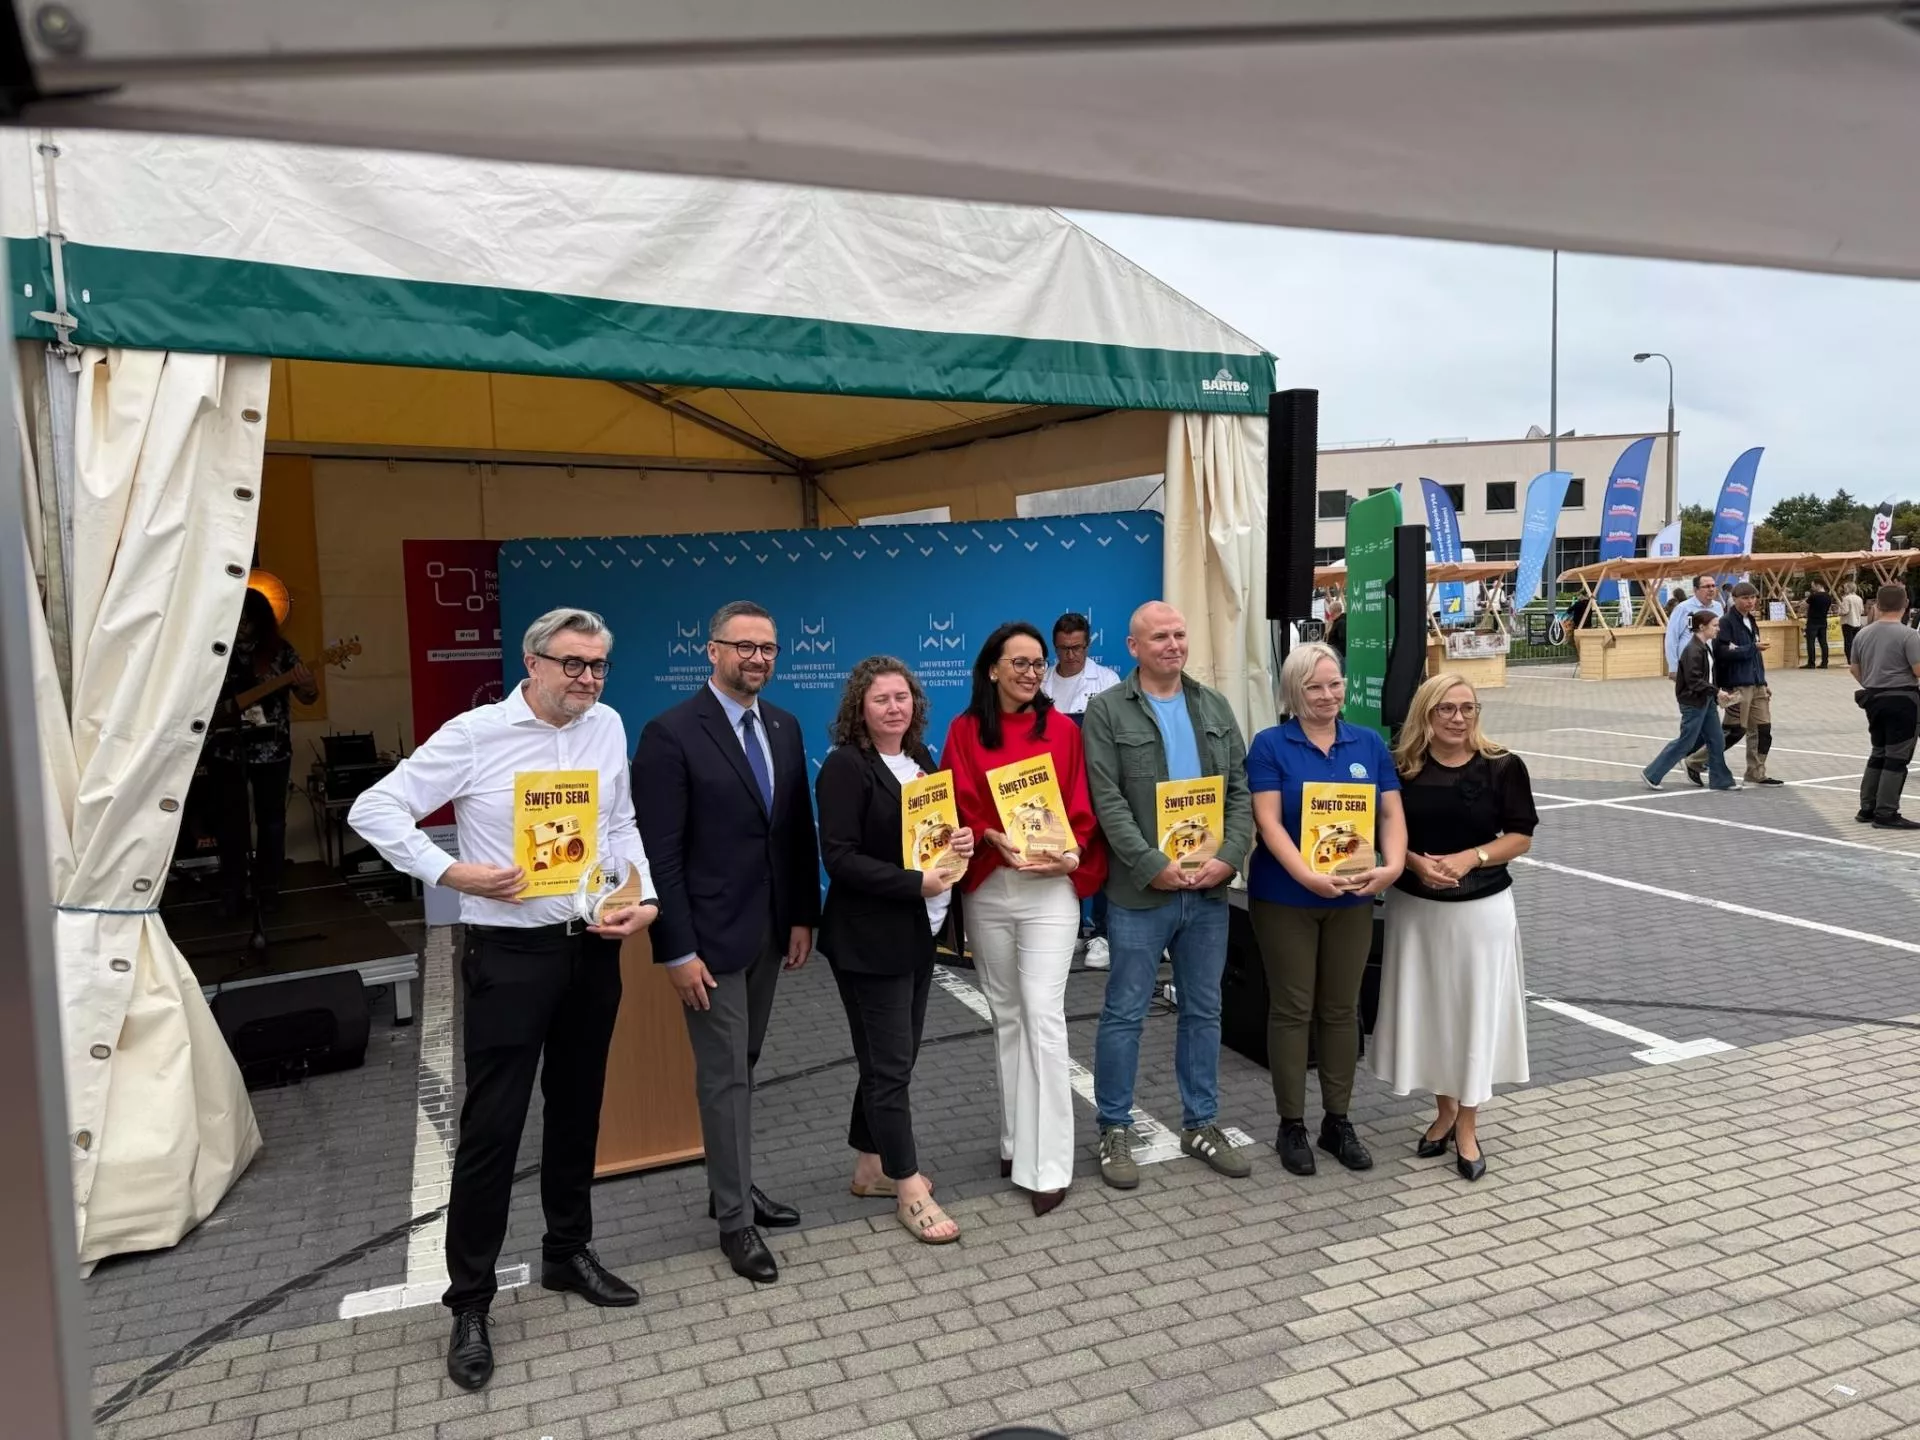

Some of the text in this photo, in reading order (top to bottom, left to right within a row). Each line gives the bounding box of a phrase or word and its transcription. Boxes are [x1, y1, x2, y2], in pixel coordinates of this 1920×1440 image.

[998, 771, 1050, 796] ŚWIĘTO SERA
[525, 789, 590, 809] ŚWIĘTO SERA
[907, 788, 948, 810] ŚWIĘTO SERA
[1164, 793, 1216, 811] ŚWIĘTO SERA
[1311, 797, 1367, 814] ŚWIĘTO SERA
